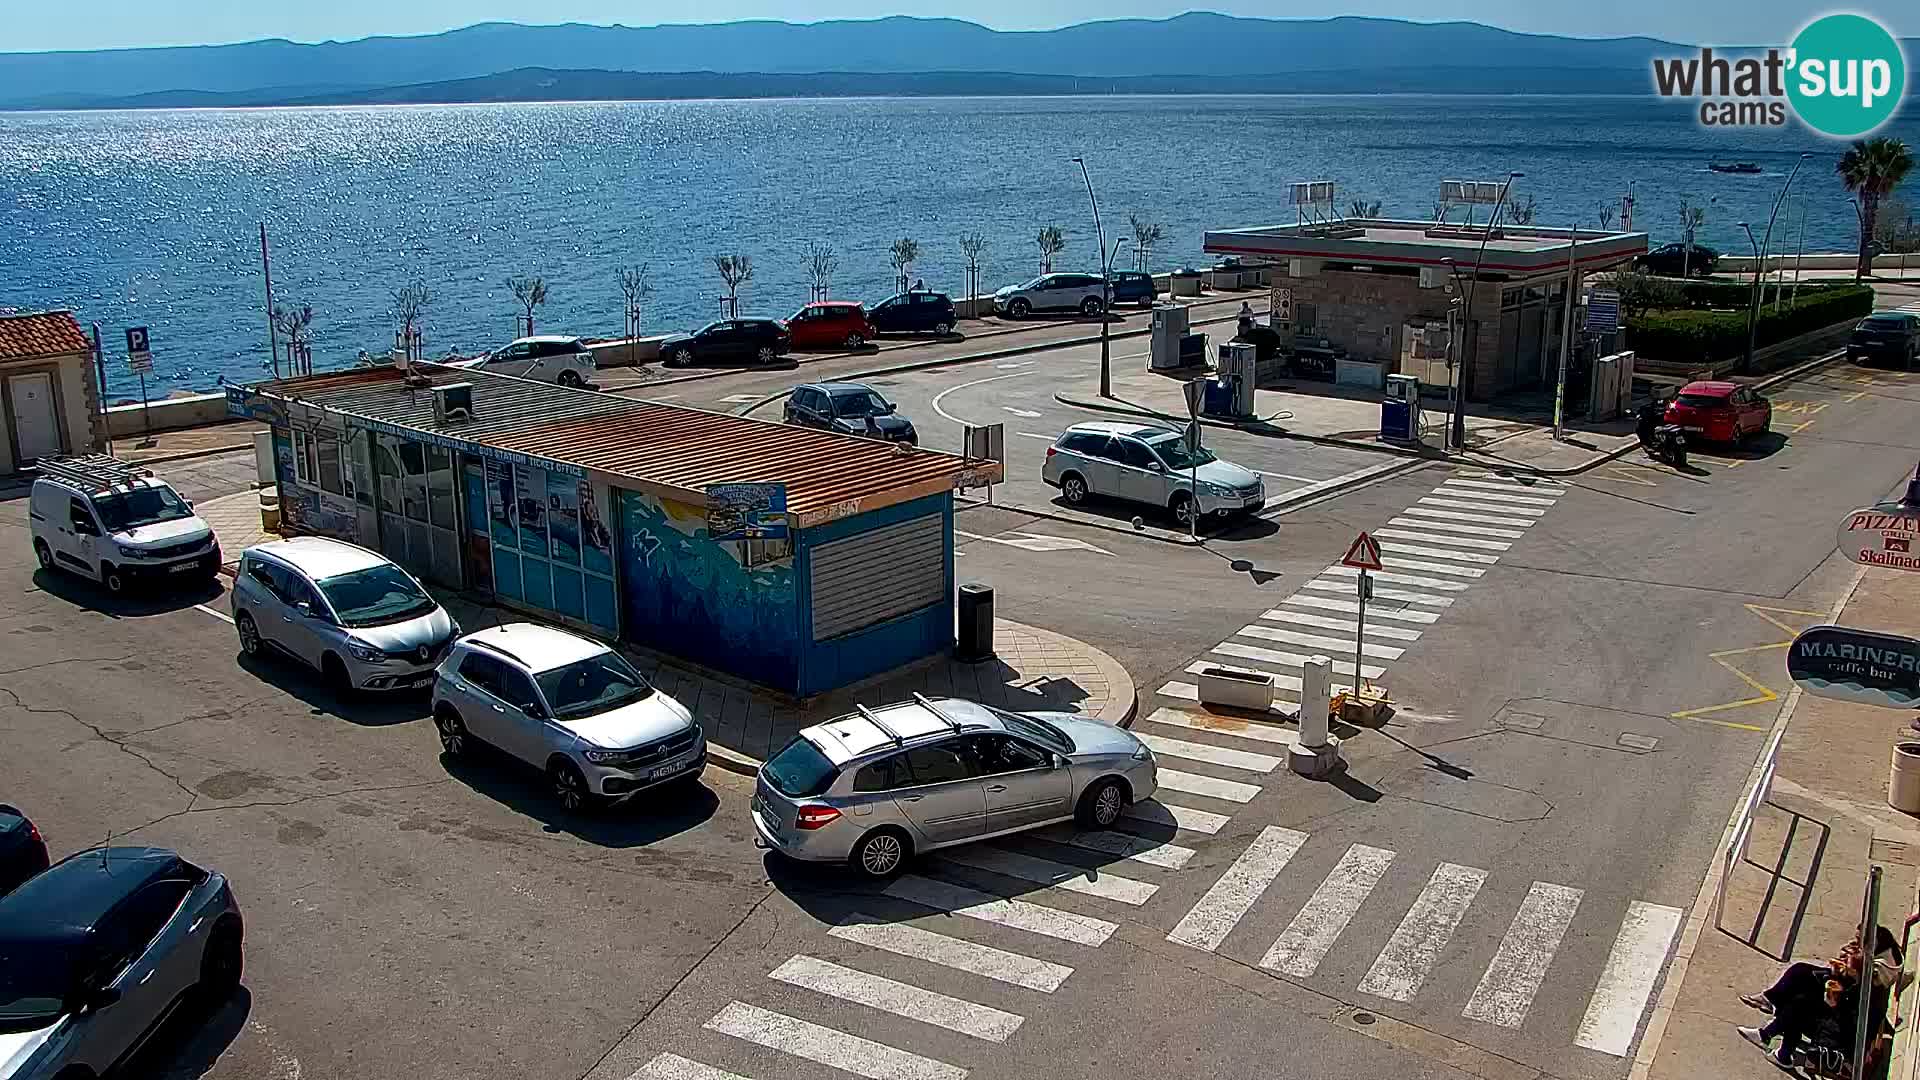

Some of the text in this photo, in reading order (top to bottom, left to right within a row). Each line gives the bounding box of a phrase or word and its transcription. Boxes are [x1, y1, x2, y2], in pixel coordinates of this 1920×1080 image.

[131, 331, 143, 349] P
[494, 449, 527, 465] STATION
[529, 457, 555, 471] TICKET
[556, 463, 584, 477] OFFICE
[1848, 515, 1920, 533] PIZZE
[1881, 530, 1915, 541] GRILL
[1828, 661, 1897, 681] caffe bar
